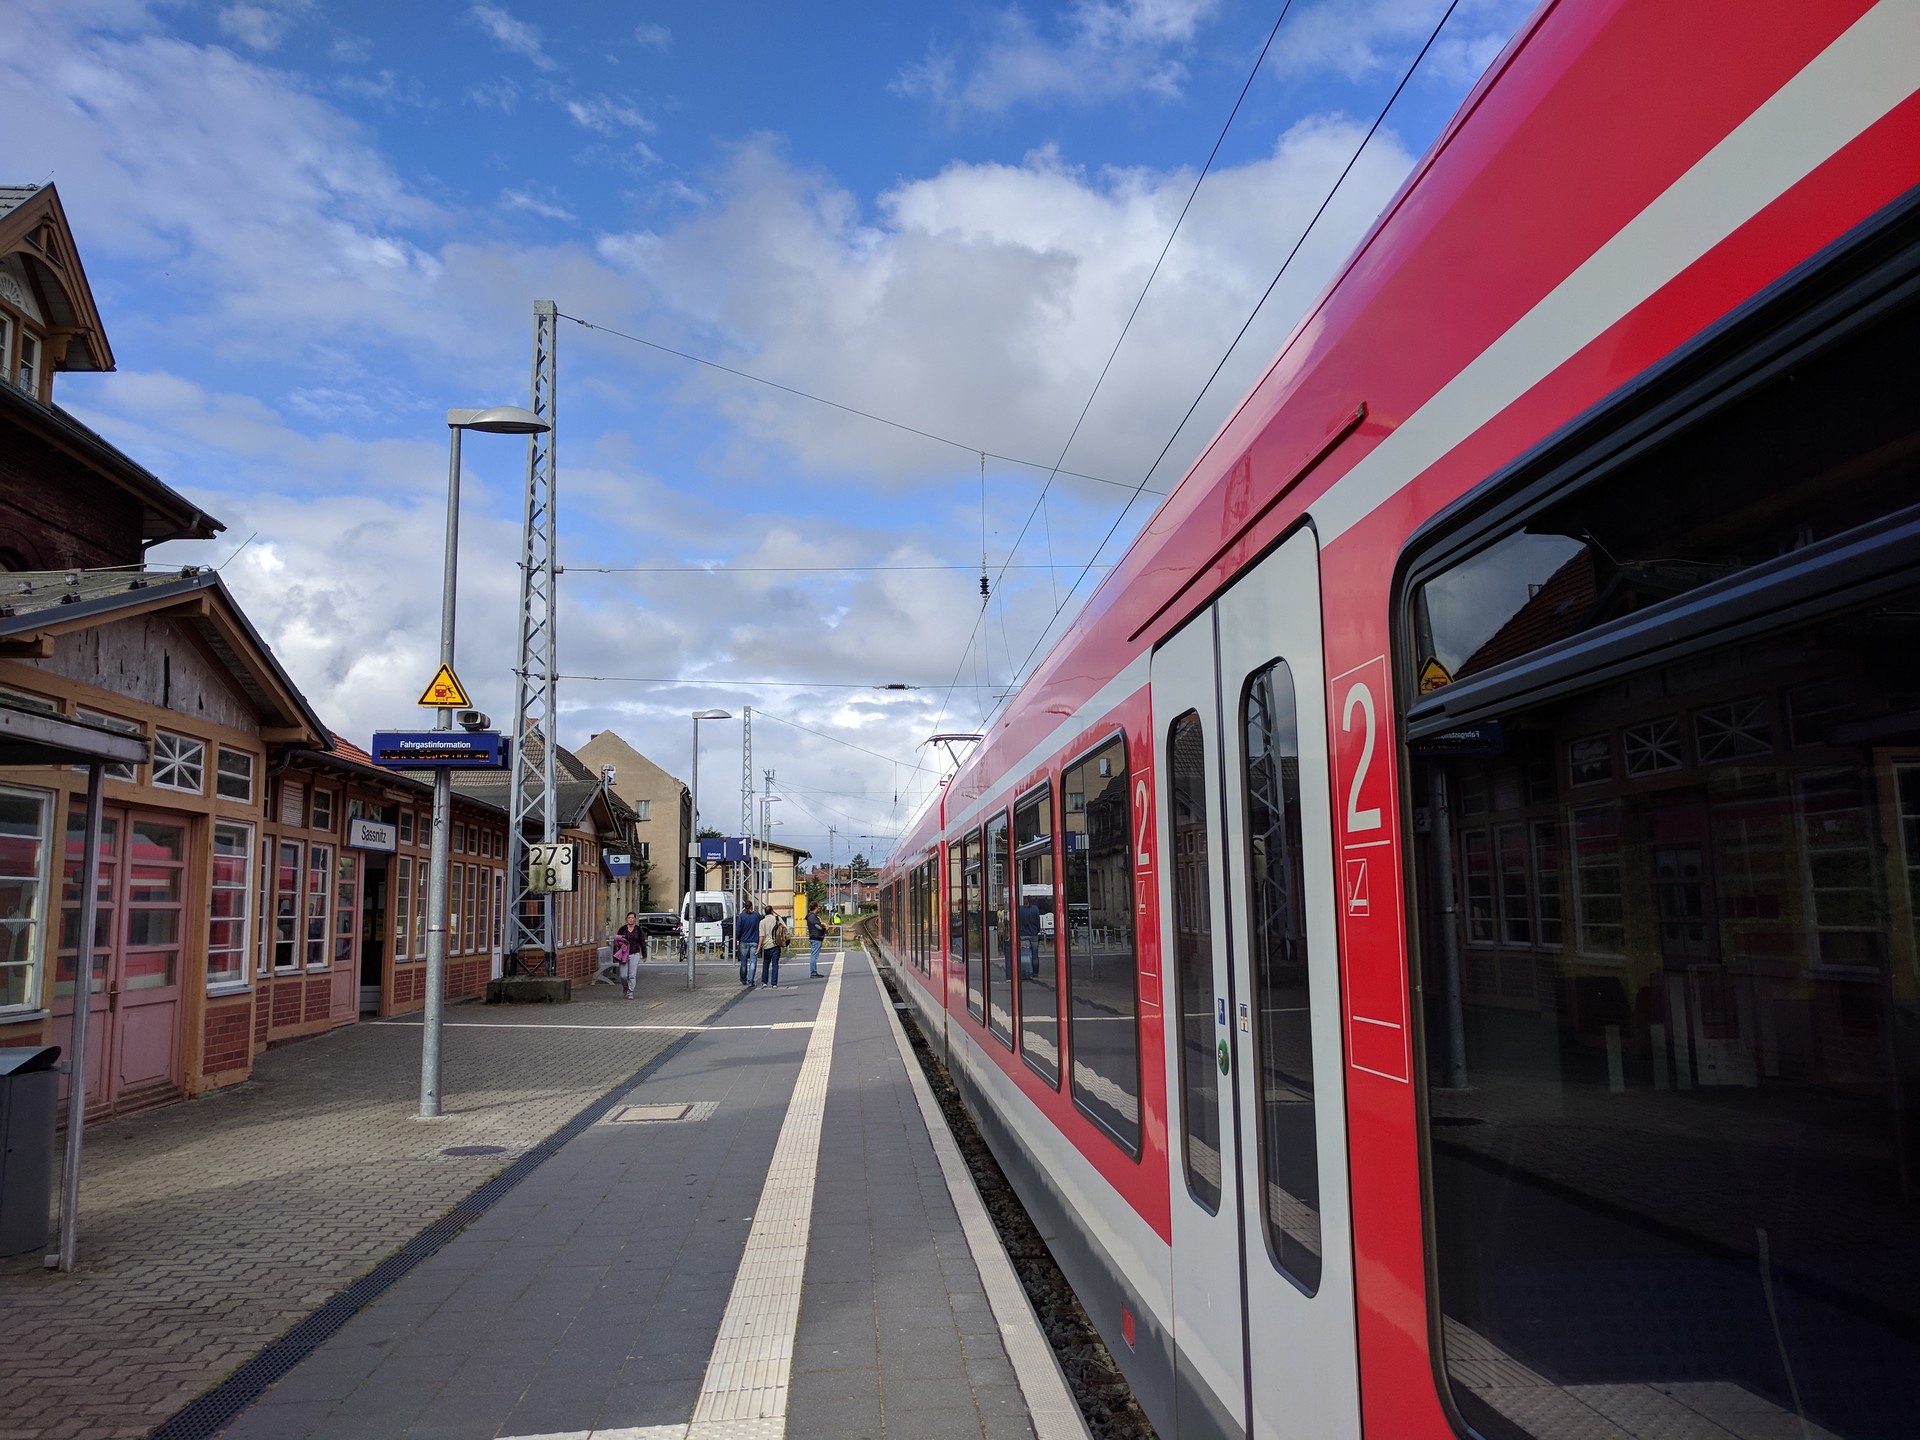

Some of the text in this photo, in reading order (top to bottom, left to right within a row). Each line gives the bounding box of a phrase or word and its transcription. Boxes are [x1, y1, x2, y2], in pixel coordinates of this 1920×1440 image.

[400, 741, 471, 749] Fahrgastinformation
[1343, 682, 1381, 832] 2
[1136, 780, 1149, 865] 2
[361, 825, 386, 843] Sassnitz
[530, 847, 571, 865] 273
[739, 839, 747, 856] 1
[545, 868, 556, 886] 8
